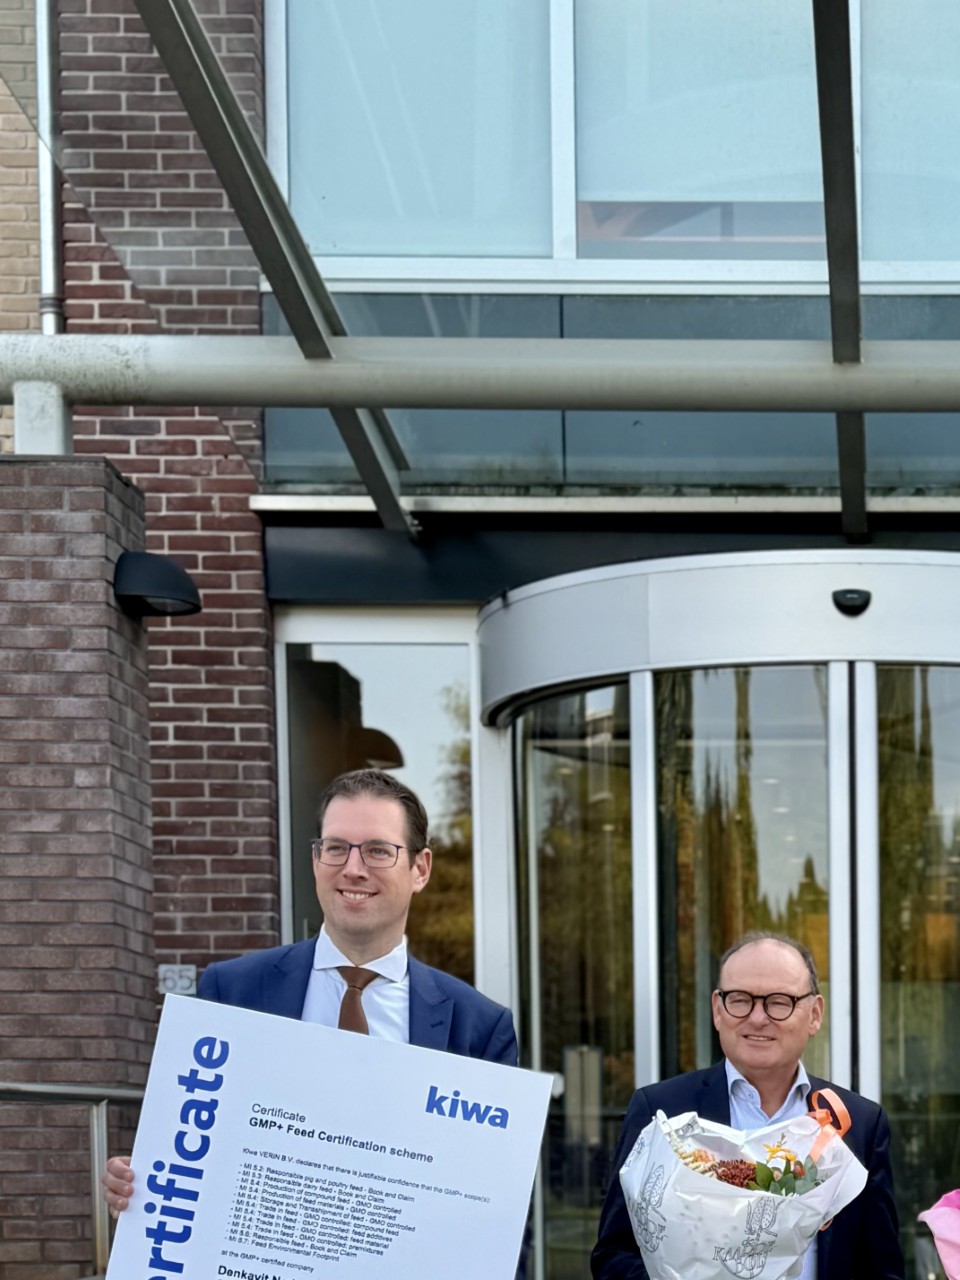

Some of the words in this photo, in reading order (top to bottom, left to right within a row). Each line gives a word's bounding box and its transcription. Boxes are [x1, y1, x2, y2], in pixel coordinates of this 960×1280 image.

[251, 1103, 306, 1123] Certificate
[425, 1085, 510, 1131] kiwa
[249, 1117, 283, 1130] GMP+
[286, 1124, 315, 1138] Feed
[318, 1131, 386, 1153] Certification
[389, 1147, 433, 1163] scheme
